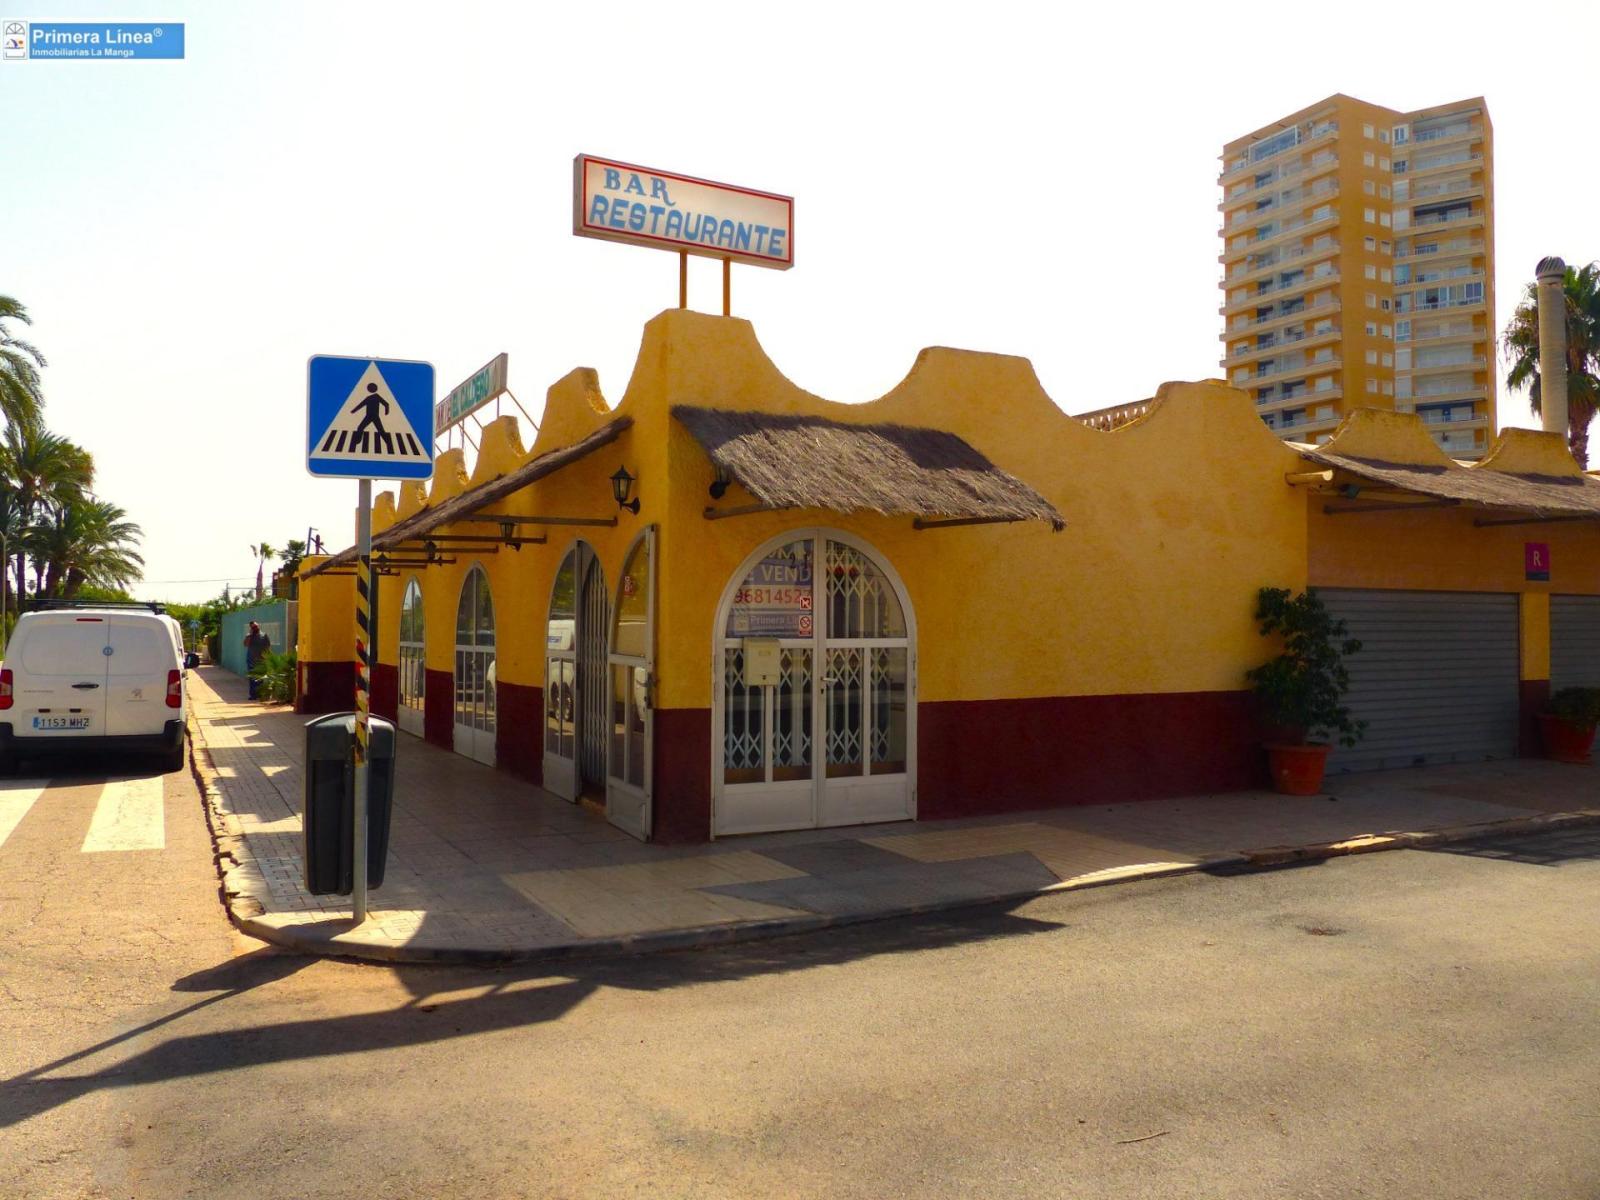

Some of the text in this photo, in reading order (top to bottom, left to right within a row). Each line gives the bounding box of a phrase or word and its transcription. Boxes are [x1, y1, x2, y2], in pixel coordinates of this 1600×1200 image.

[604, 167, 676, 206] BAR
[589, 194, 786, 256] RESTAURANTE
[1533, 550, 1543, 567] R
[42, 718, 66, 727] 1153
